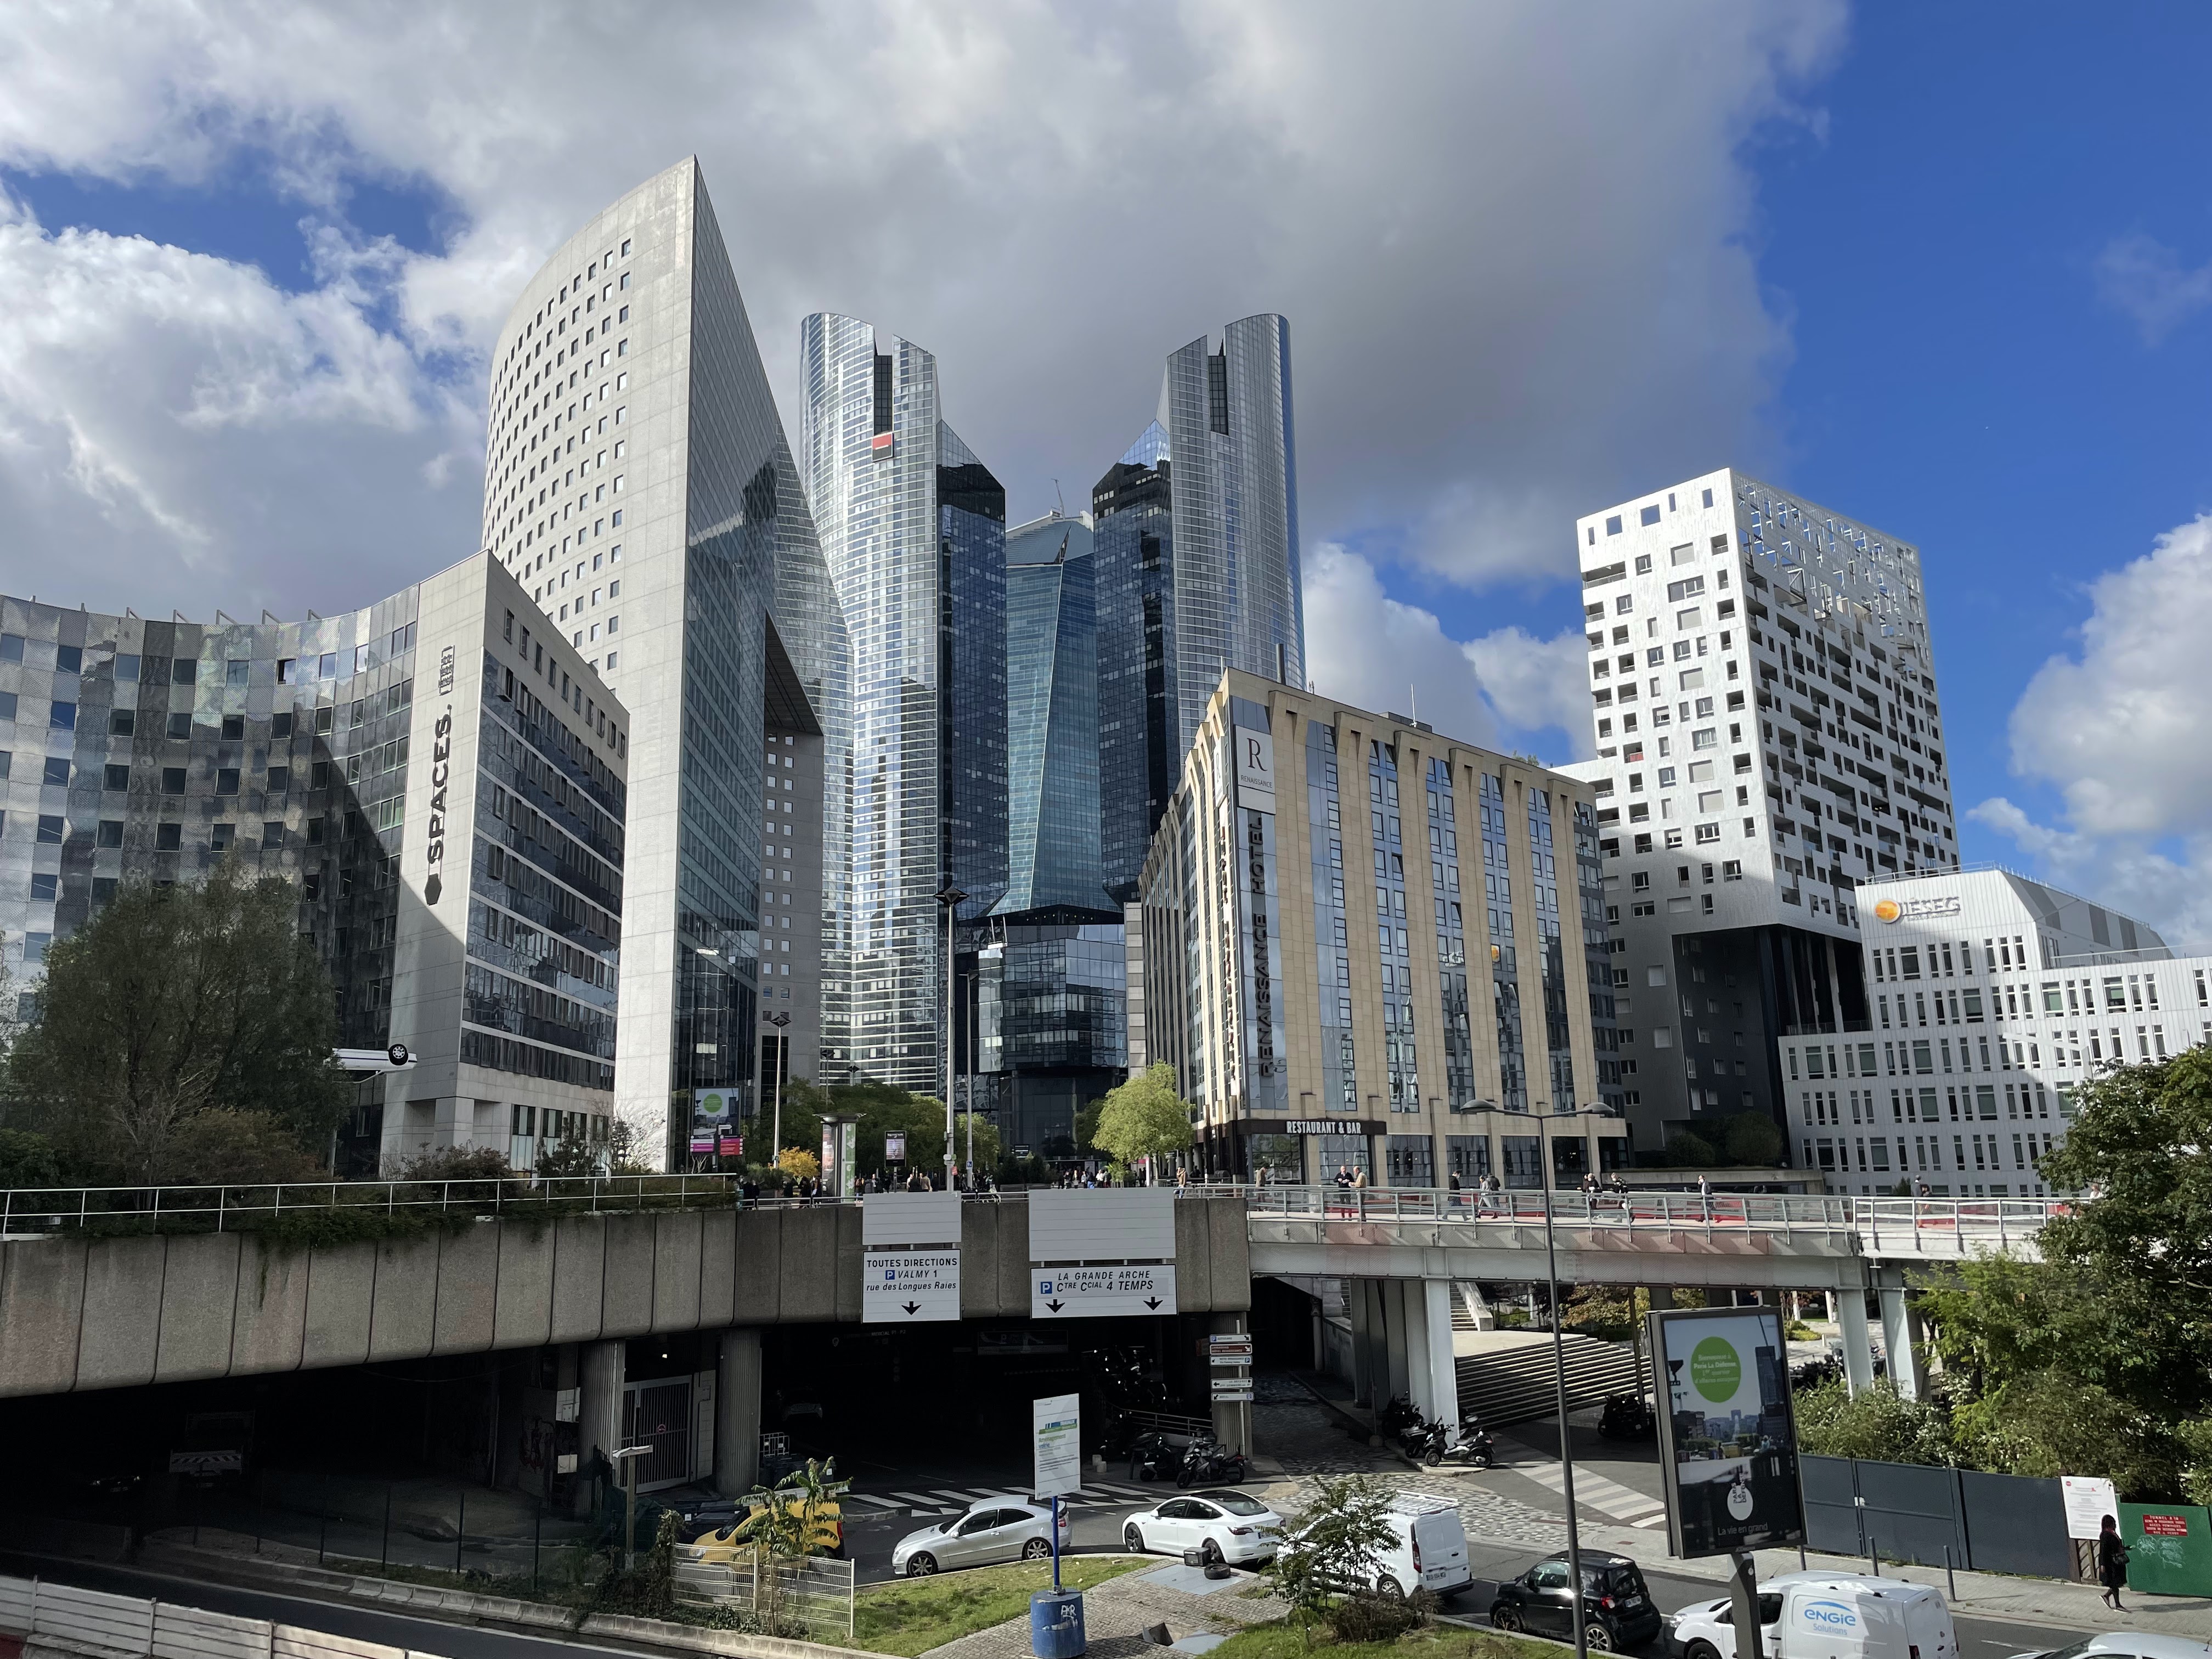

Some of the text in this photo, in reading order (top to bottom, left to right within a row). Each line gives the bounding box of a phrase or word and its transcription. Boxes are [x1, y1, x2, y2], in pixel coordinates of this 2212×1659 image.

[1247, 738, 1268, 771] R
[1241, 775, 1272, 788] RENAISSANCE
[1249, 817, 1273, 1077] RENAISSANCE HOTEL
[1286, 1121, 1361, 1134] RESTAURANT & BAR
[867, 1258, 957, 1267] TOUTES DIRECTIONS
[898, 1270, 929, 1278] VALMY
[1075, 1271, 1113, 1280] GRANDE
[1119, 1271, 1150, 1279] ARCHE
[898, 1282, 932, 1292] Longues
[1107, 1281, 1113, 1290] 4
[1118, 1280, 1153, 1290] TEMPS
[1718, 1527, 1726, 1536] La
[1727, 1525, 1737, 1534] vie
[1748, 1522, 1768, 1534] grand
[1813, 1623, 1848, 1635] Solutions
